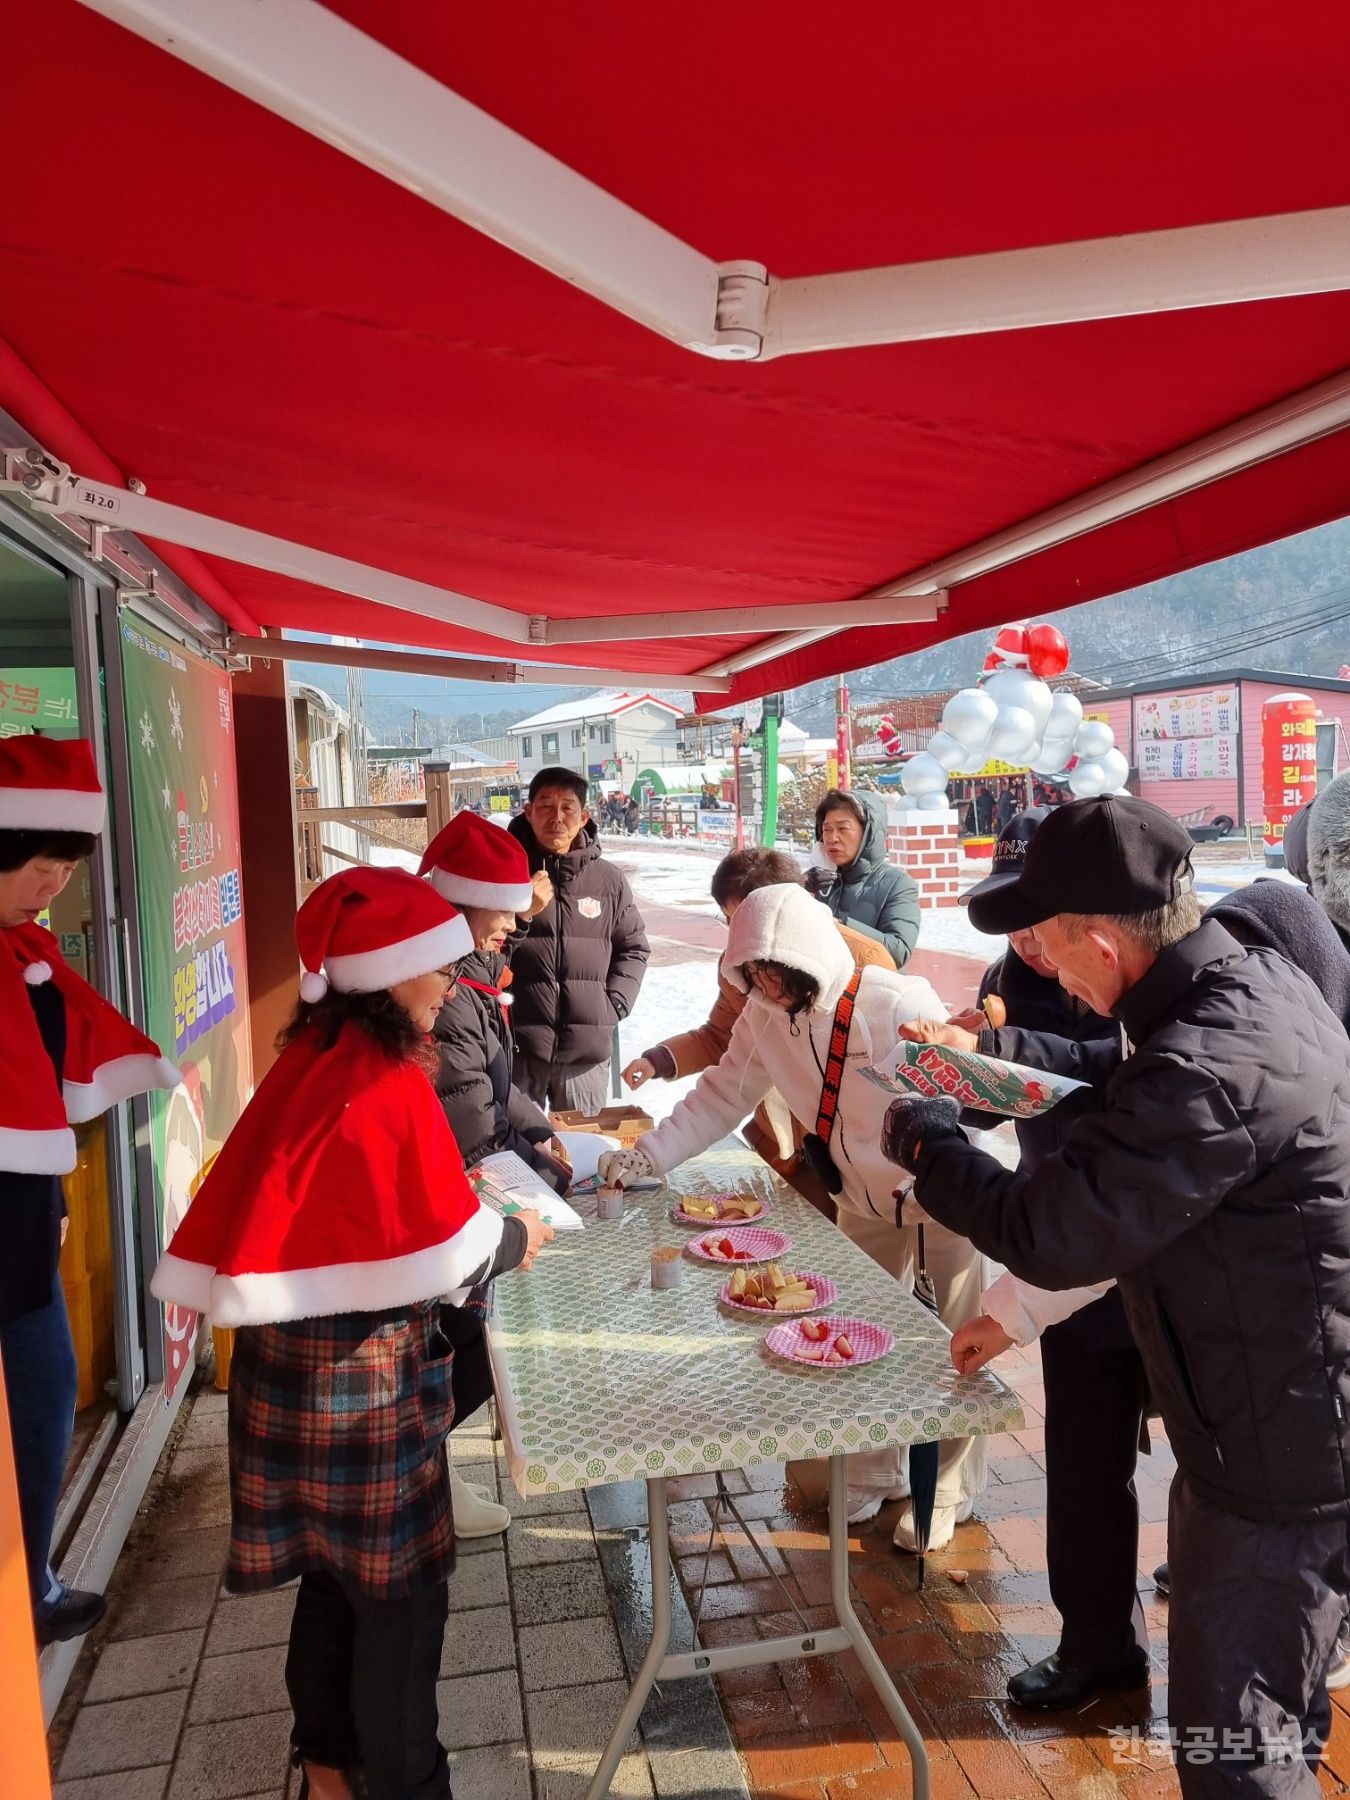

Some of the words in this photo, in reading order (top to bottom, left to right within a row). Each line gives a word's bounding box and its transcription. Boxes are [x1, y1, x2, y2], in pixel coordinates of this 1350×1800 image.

[84, 492, 97, 505] 좌
[98, 496, 115, 511] 2.0
[173, 876, 221, 953] 분천산타마을
[219, 868, 242, 928] 방문을
[173, 940, 235, 1041] 환영합니다
[836, 996, 854, 1025] NIKE
[830, 1027, 848, 1058] NIKE
[825, 1060, 843, 1089] NIKE
[896, 1062, 939, 1097] 봉화딸기
[820, 1089, 837, 1118] NIKE
